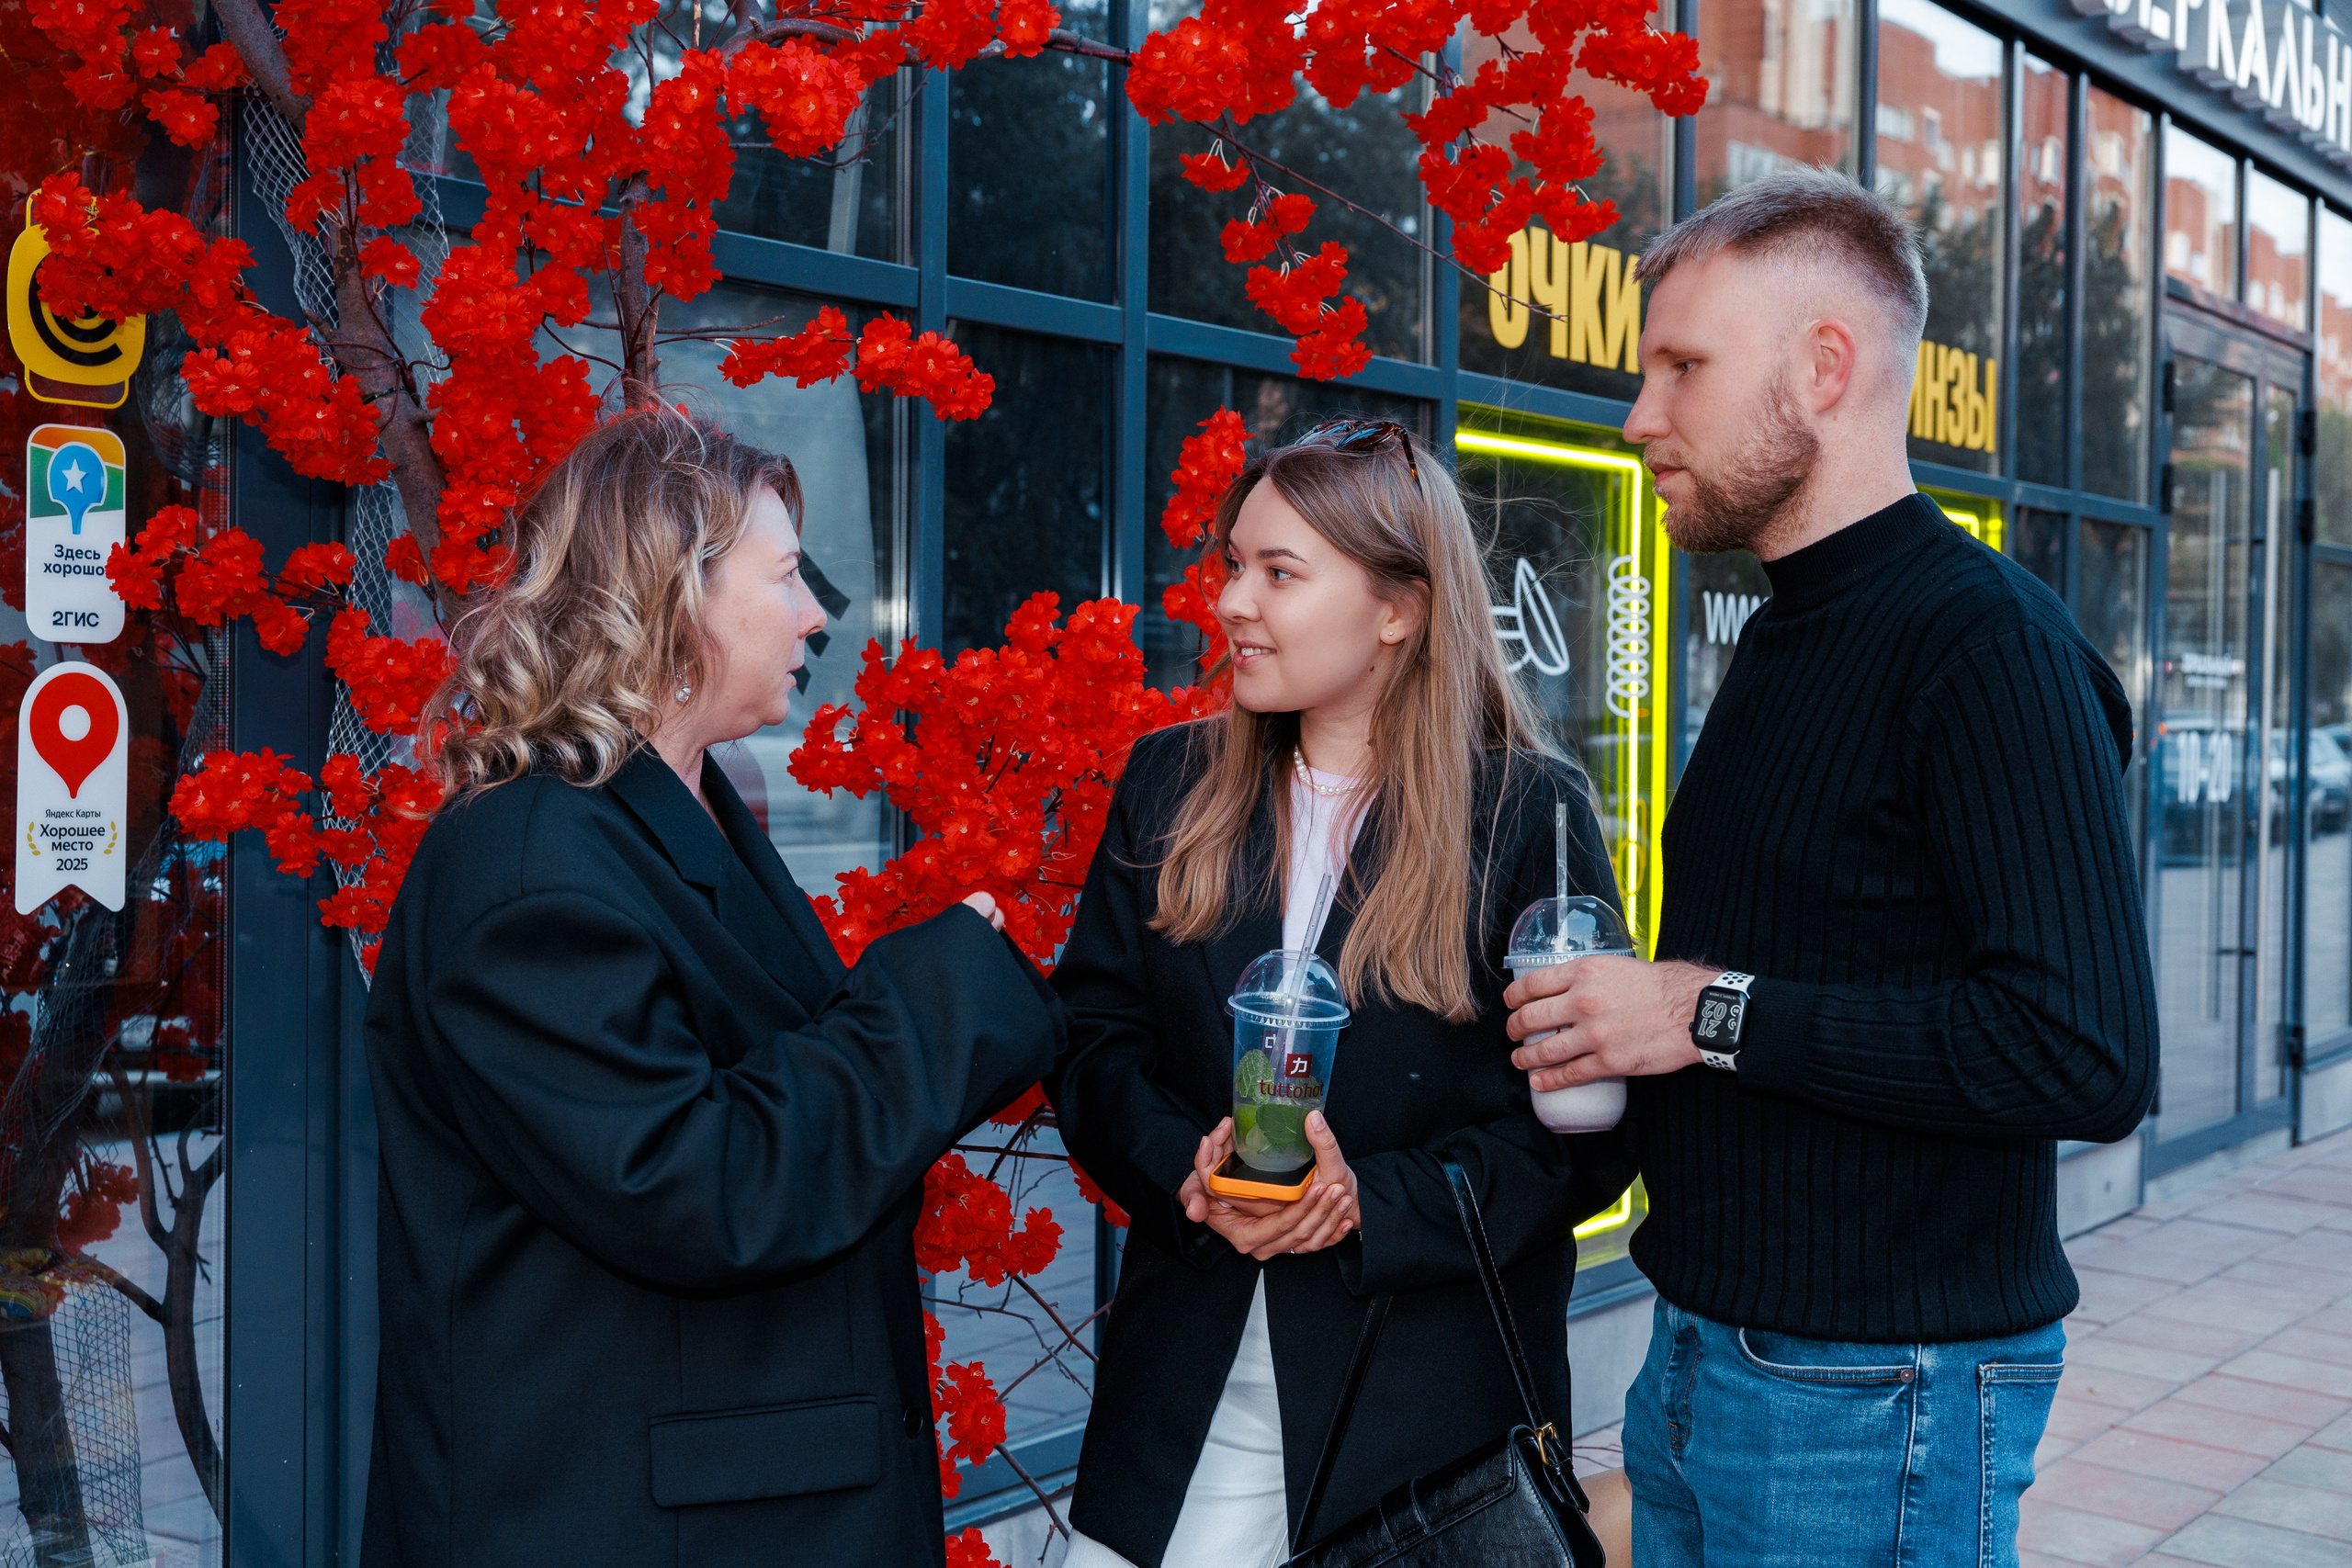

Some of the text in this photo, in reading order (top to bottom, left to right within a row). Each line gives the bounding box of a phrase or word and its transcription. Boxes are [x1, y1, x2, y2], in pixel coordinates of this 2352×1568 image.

[1489, 226, 1642, 375] ОЧКИ
[1906, 339, 1997, 454] ИНЗЫ
[54, 544, 100, 561] Здесь
[43, 562, 105, 578] хорошо
[52, 611, 99, 627] 2ГИС
[45, 808, 101, 819] Яндекс Карты
[40, 823, 106, 840] Хорошее
[51, 841, 94, 852] место
[56, 858, 88, 871] 2025
